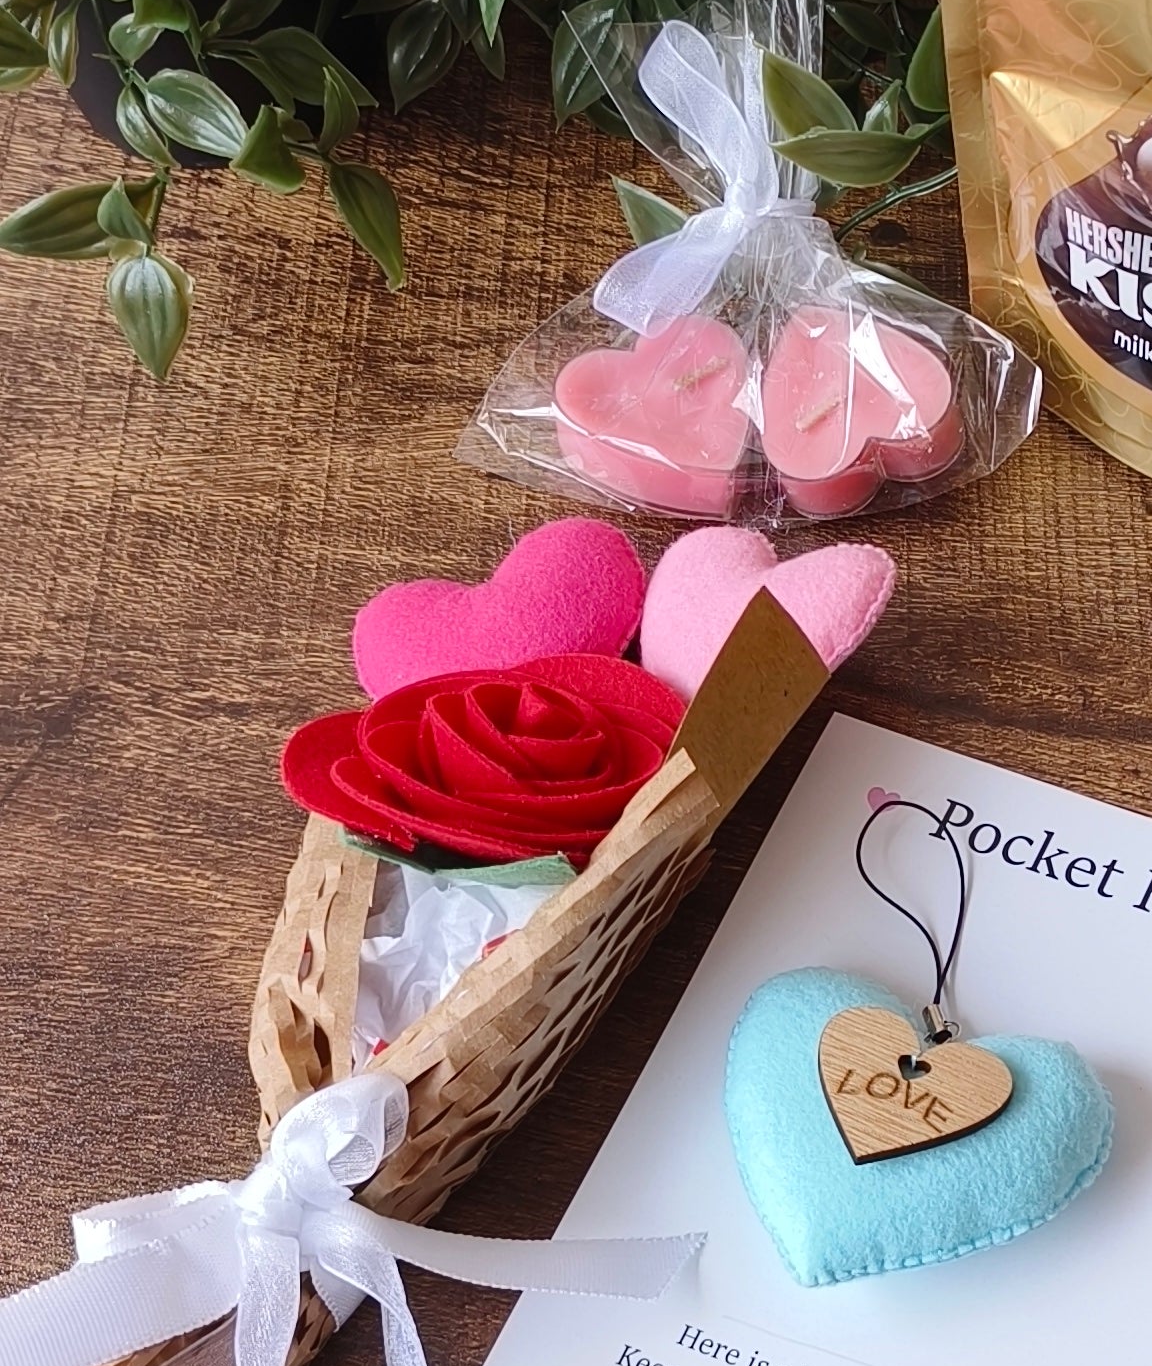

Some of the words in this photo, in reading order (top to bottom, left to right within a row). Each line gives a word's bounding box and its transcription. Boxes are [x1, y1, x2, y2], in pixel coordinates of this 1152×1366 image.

[928, 798, 1124, 898] Pocket
[836, 1067, 955, 1135] LOVE
[676, 1324, 740, 1365] Here
